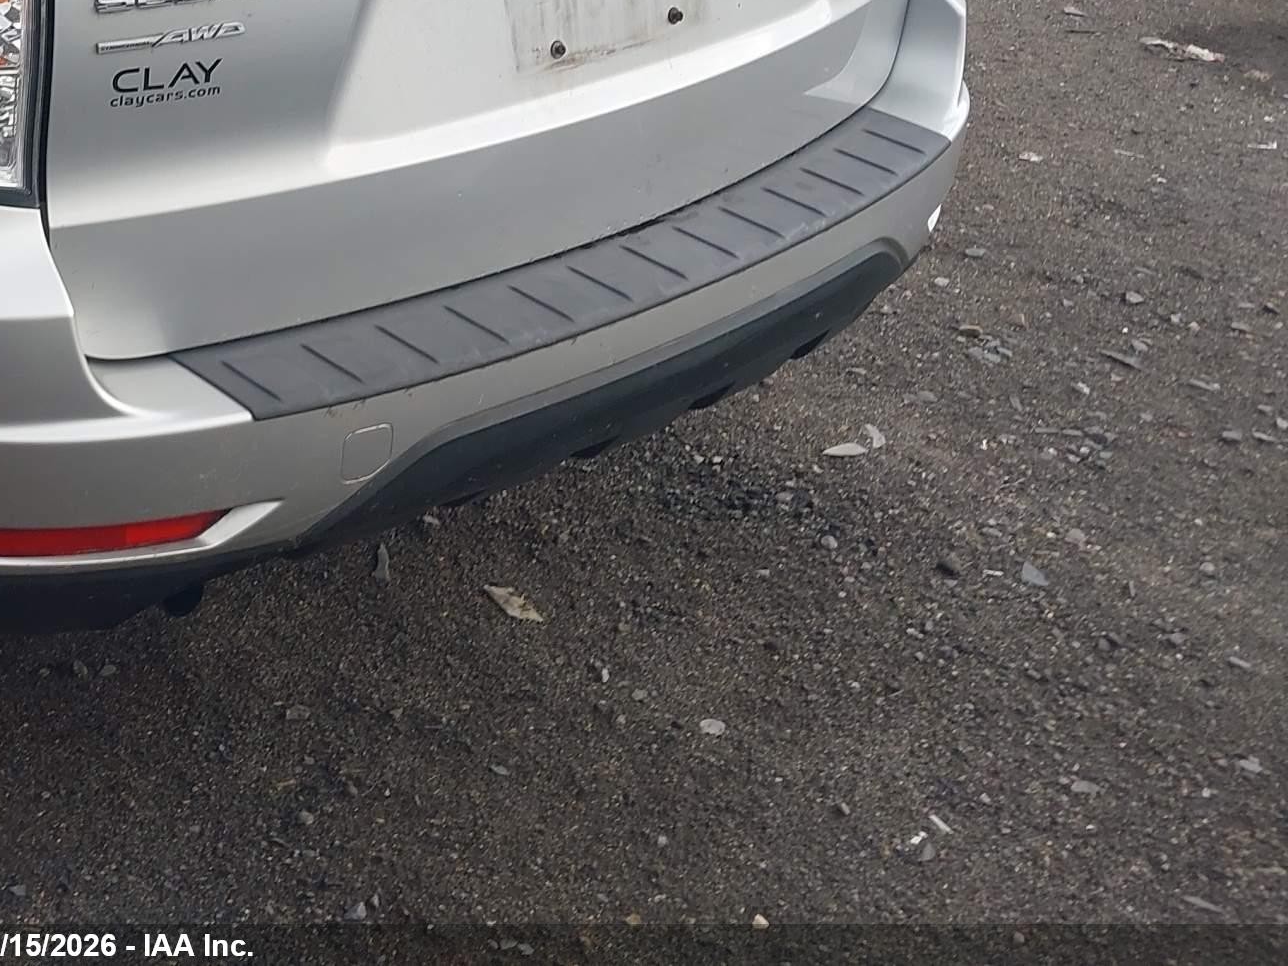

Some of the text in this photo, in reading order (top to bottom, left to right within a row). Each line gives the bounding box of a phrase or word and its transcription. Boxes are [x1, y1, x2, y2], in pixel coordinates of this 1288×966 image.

[152, 22, 245, 47] AWD
[112, 58, 223, 93] CLAY
[110, 86, 221, 108] claycars.com
